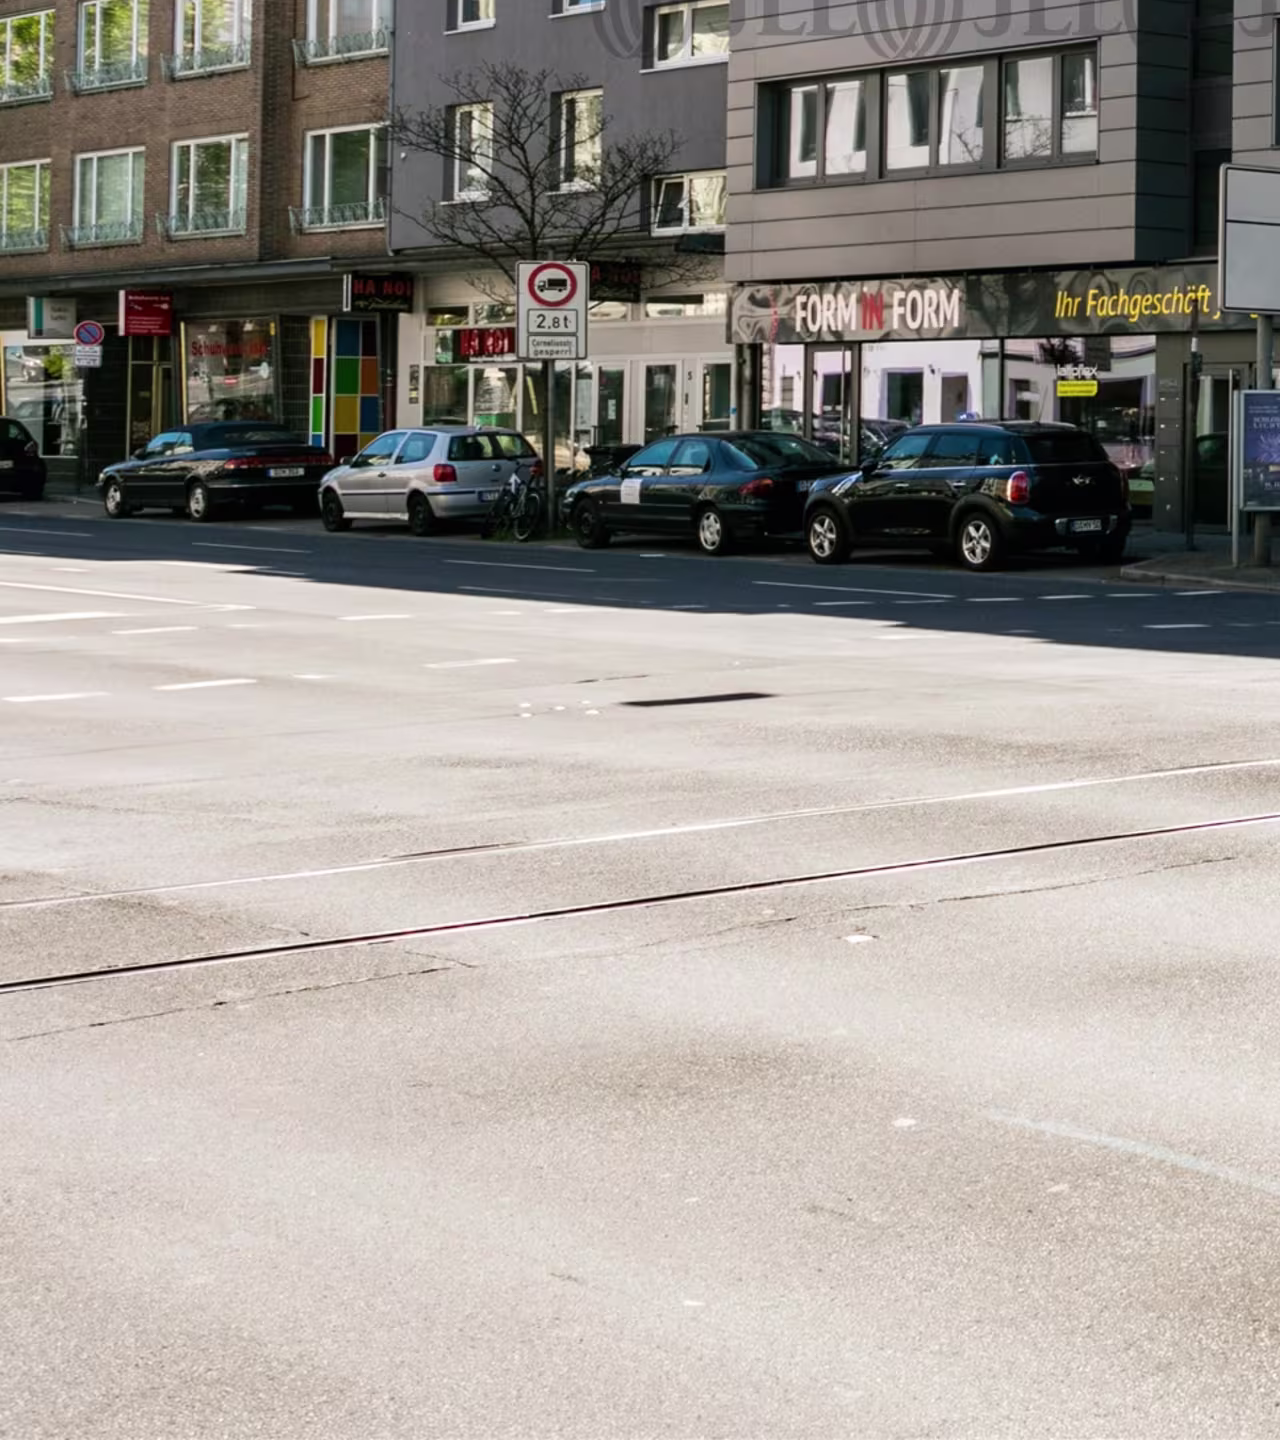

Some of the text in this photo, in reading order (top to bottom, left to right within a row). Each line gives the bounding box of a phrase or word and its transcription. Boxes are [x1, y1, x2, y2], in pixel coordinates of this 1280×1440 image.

[353, 279, 375, 294] HA
[795, 292, 856, 332] FORM
[893, 288, 959, 330] FORM
[1055, 284, 1211, 322] Ihr Fachgeschäft
[533, 346, 572, 357] gesperrt
